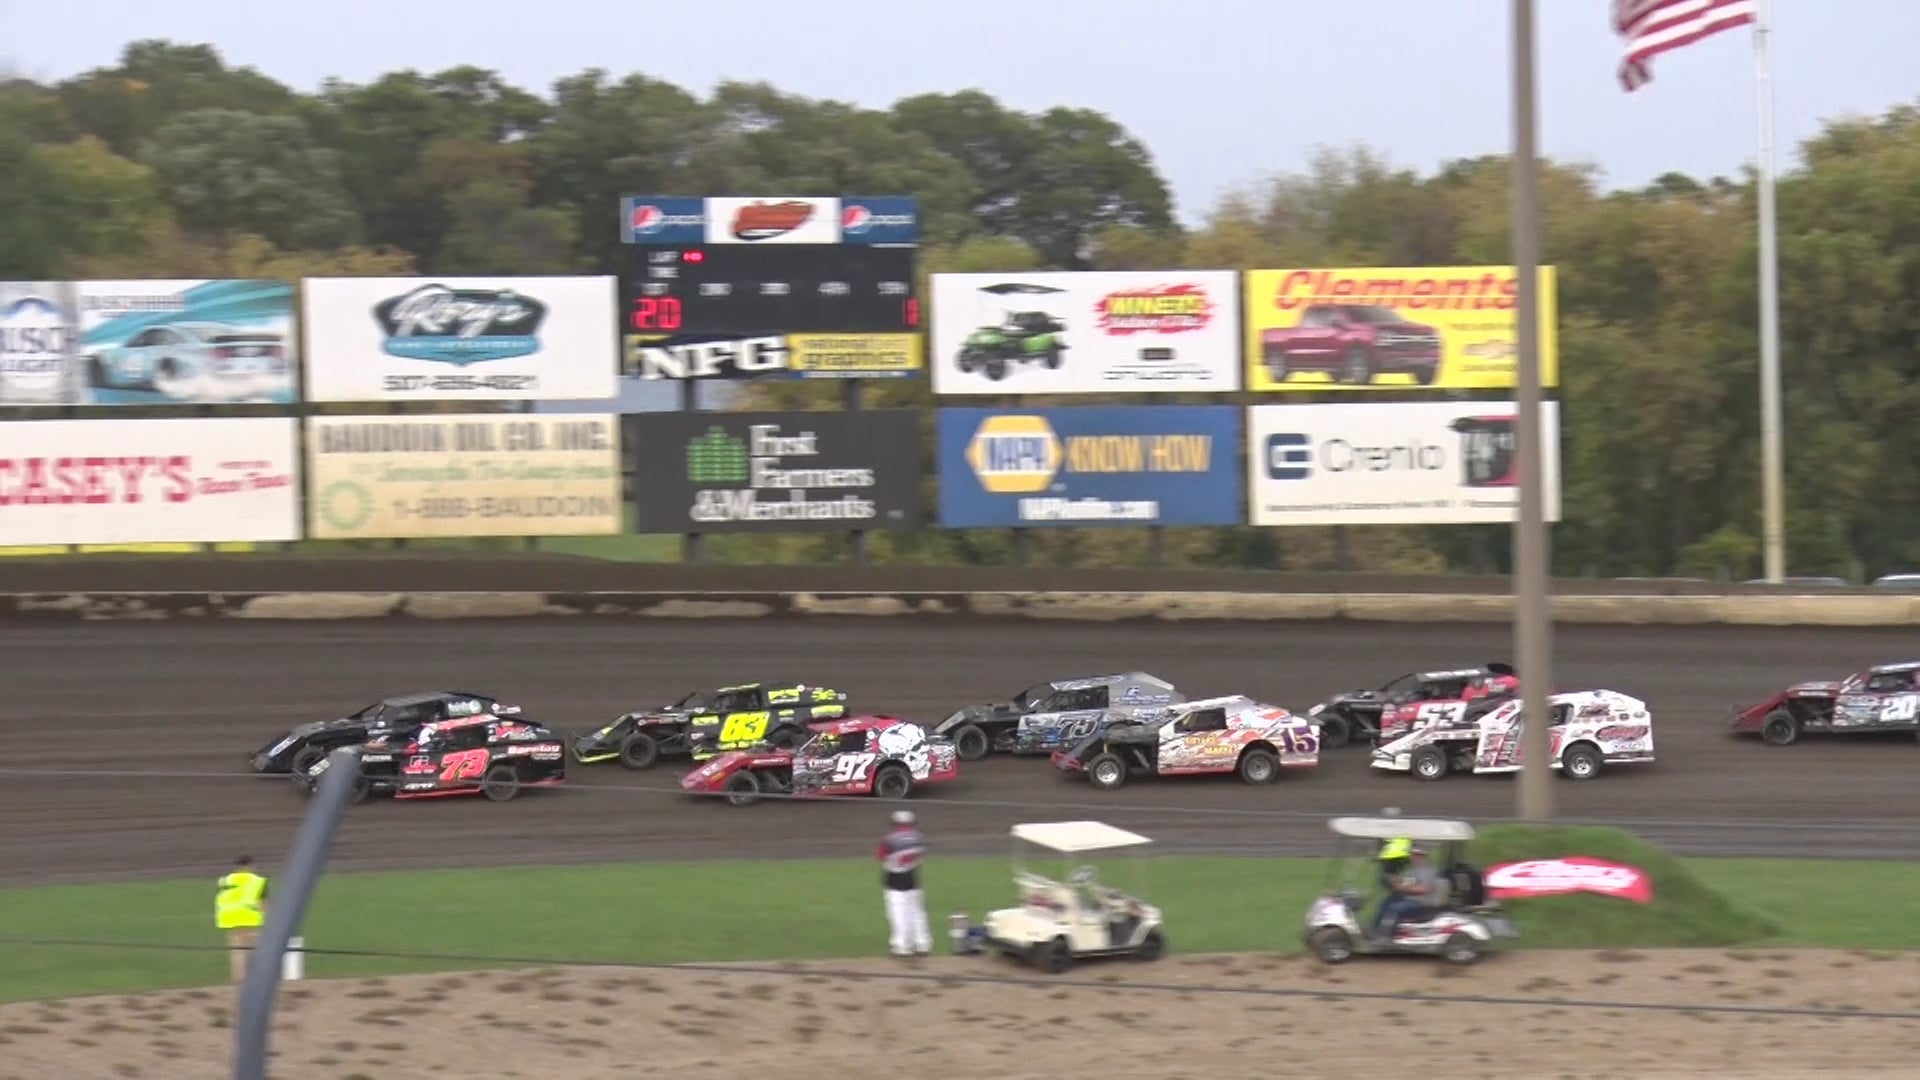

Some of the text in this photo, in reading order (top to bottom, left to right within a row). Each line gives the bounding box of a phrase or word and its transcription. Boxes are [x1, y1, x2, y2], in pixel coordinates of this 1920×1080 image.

[631, 297, 681, 329] 20
[634, 335, 789, 381] NFG
[748, 424, 819, 456] First
[1065, 435, 1146, 472] KNOW
[1148, 435, 1213, 472] HOW
[750, 456, 876, 488] Farmers
[1412, 701, 1468, 731] 53
[1879, 694, 1918, 722] 20
[720, 711, 770, 743] 83
[831, 752, 877, 783] 97
